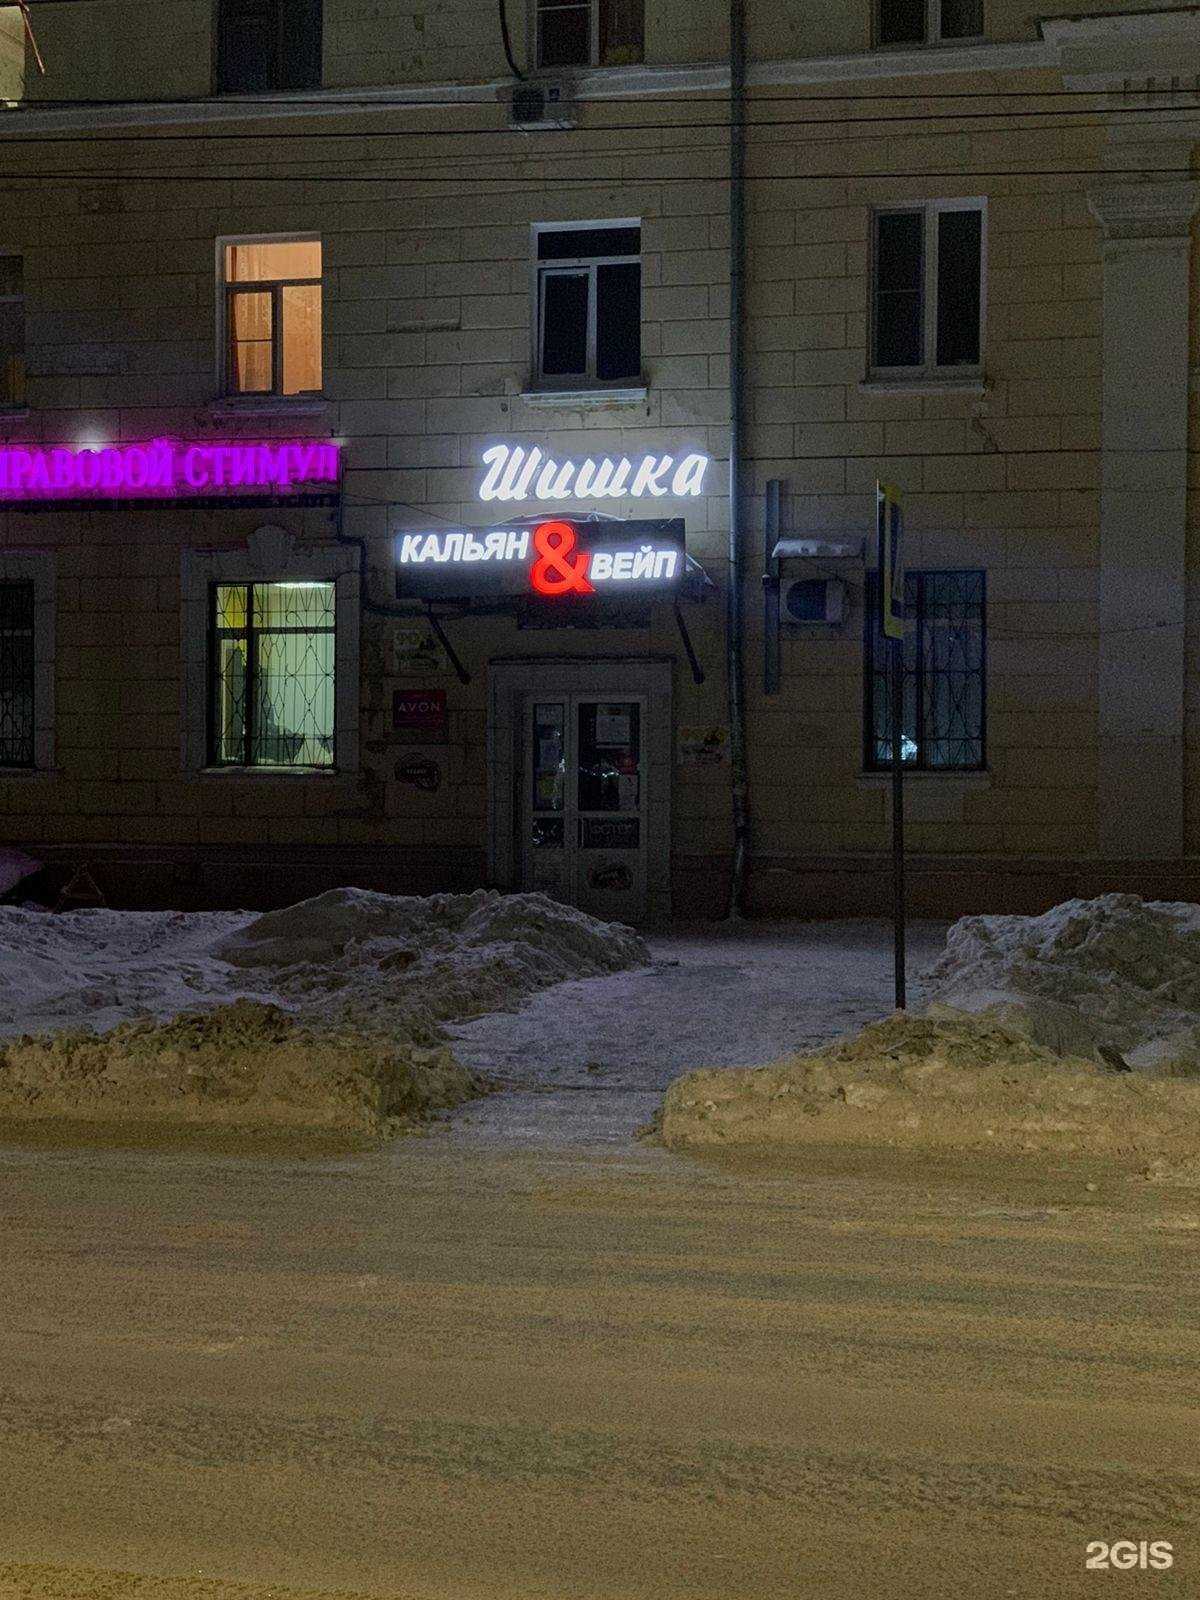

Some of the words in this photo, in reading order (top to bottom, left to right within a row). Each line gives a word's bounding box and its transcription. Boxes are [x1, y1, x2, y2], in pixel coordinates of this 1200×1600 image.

[478, 444, 708, 501] Шишка
[400, 531, 530, 563] КАЛЬЯН
[590, 545, 677, 580] ВЕЙП
[398, 702, 440, 712] AVON
